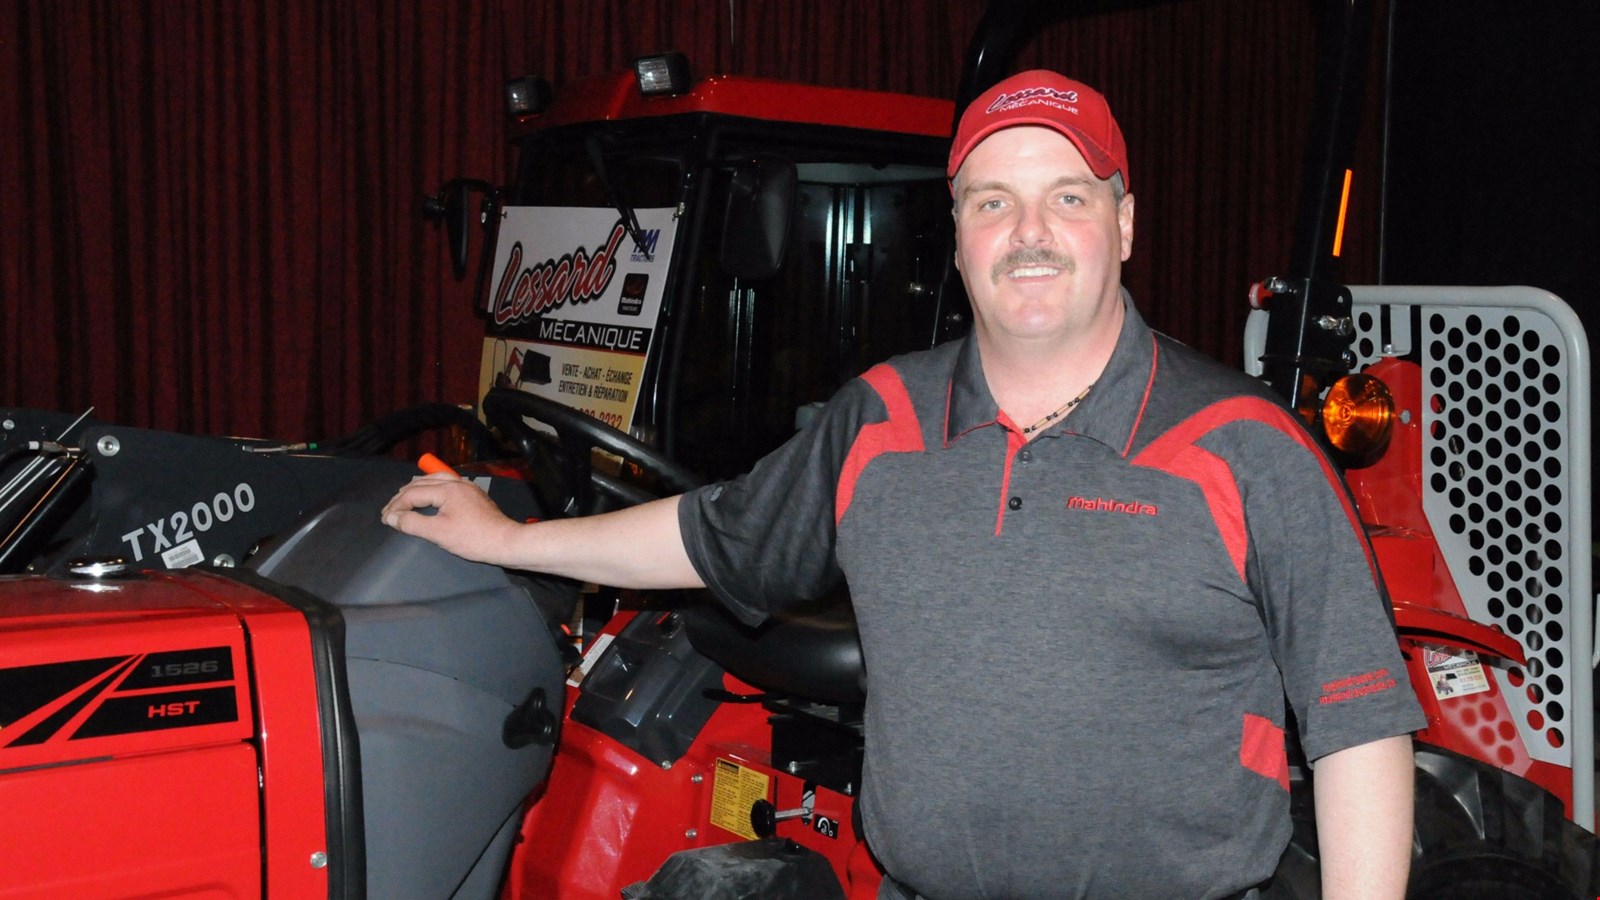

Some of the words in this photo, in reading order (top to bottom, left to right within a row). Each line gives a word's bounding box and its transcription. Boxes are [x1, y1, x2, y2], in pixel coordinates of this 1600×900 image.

[986, 87, 1078, 114] Lessard
[495, 223, 625, 325] Lessard
[562, 363, 579, 377] VENTE
[583, 366, 602, 380] ACHAT
[606, 366, 633, 385] ÉCHANGE
[559, 380, 588, 397] ENTRETIEN
[588, 385, 593, 397] &
[593, 383, 629, 403] RÉPARATION
[1067, 496, 1158, 516] Mahindra
[121, 483, 255, 562] TX2000
[152, 660, 218, 678] 1526
[147, 701, 201, 719] HST
